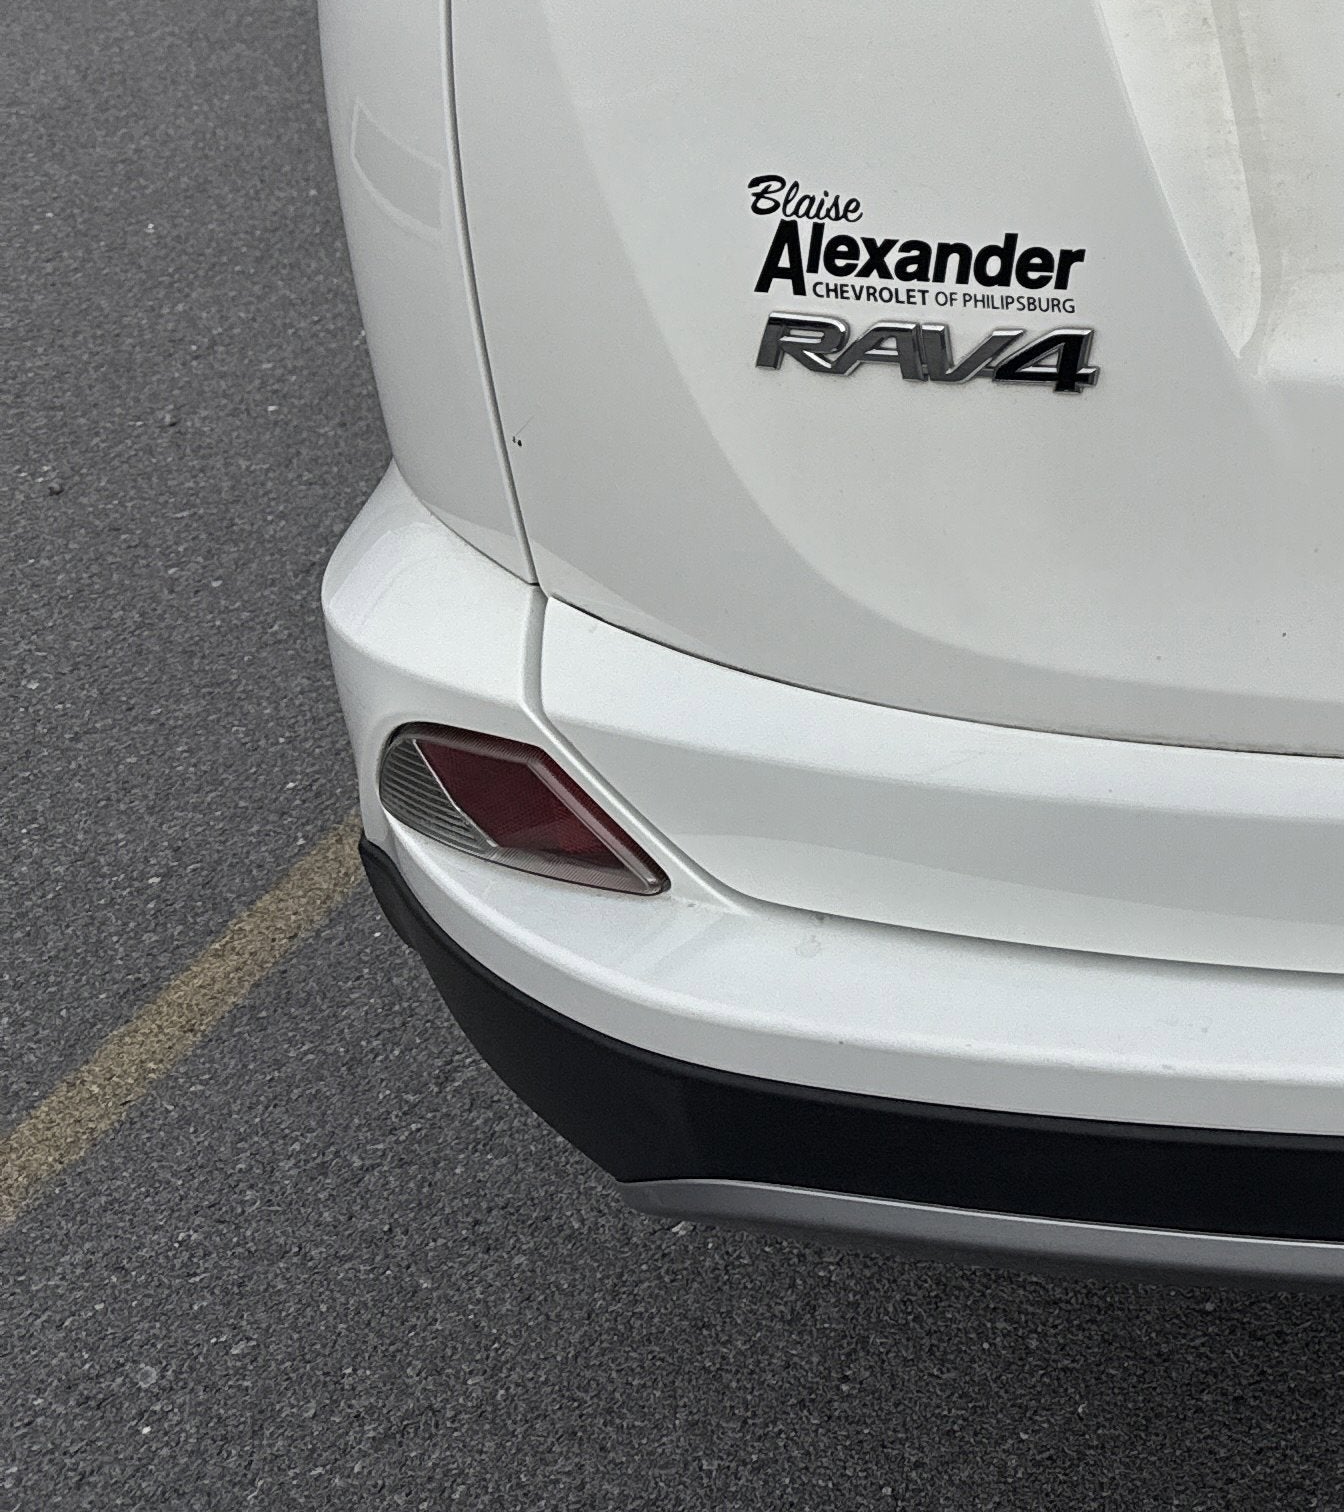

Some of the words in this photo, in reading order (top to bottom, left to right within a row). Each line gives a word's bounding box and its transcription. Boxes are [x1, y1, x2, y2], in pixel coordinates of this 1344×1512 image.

[748, 174, 863, 223] Blaise
[754, 218, 1086, 296] Alexander
[812, 281, 929, 306] CHEVROLET
[935, 291, 957, 307] OF
[963, 292, 1076, 314] PHILIPSBURG
[755, 311, 1100, 394] RAV4
